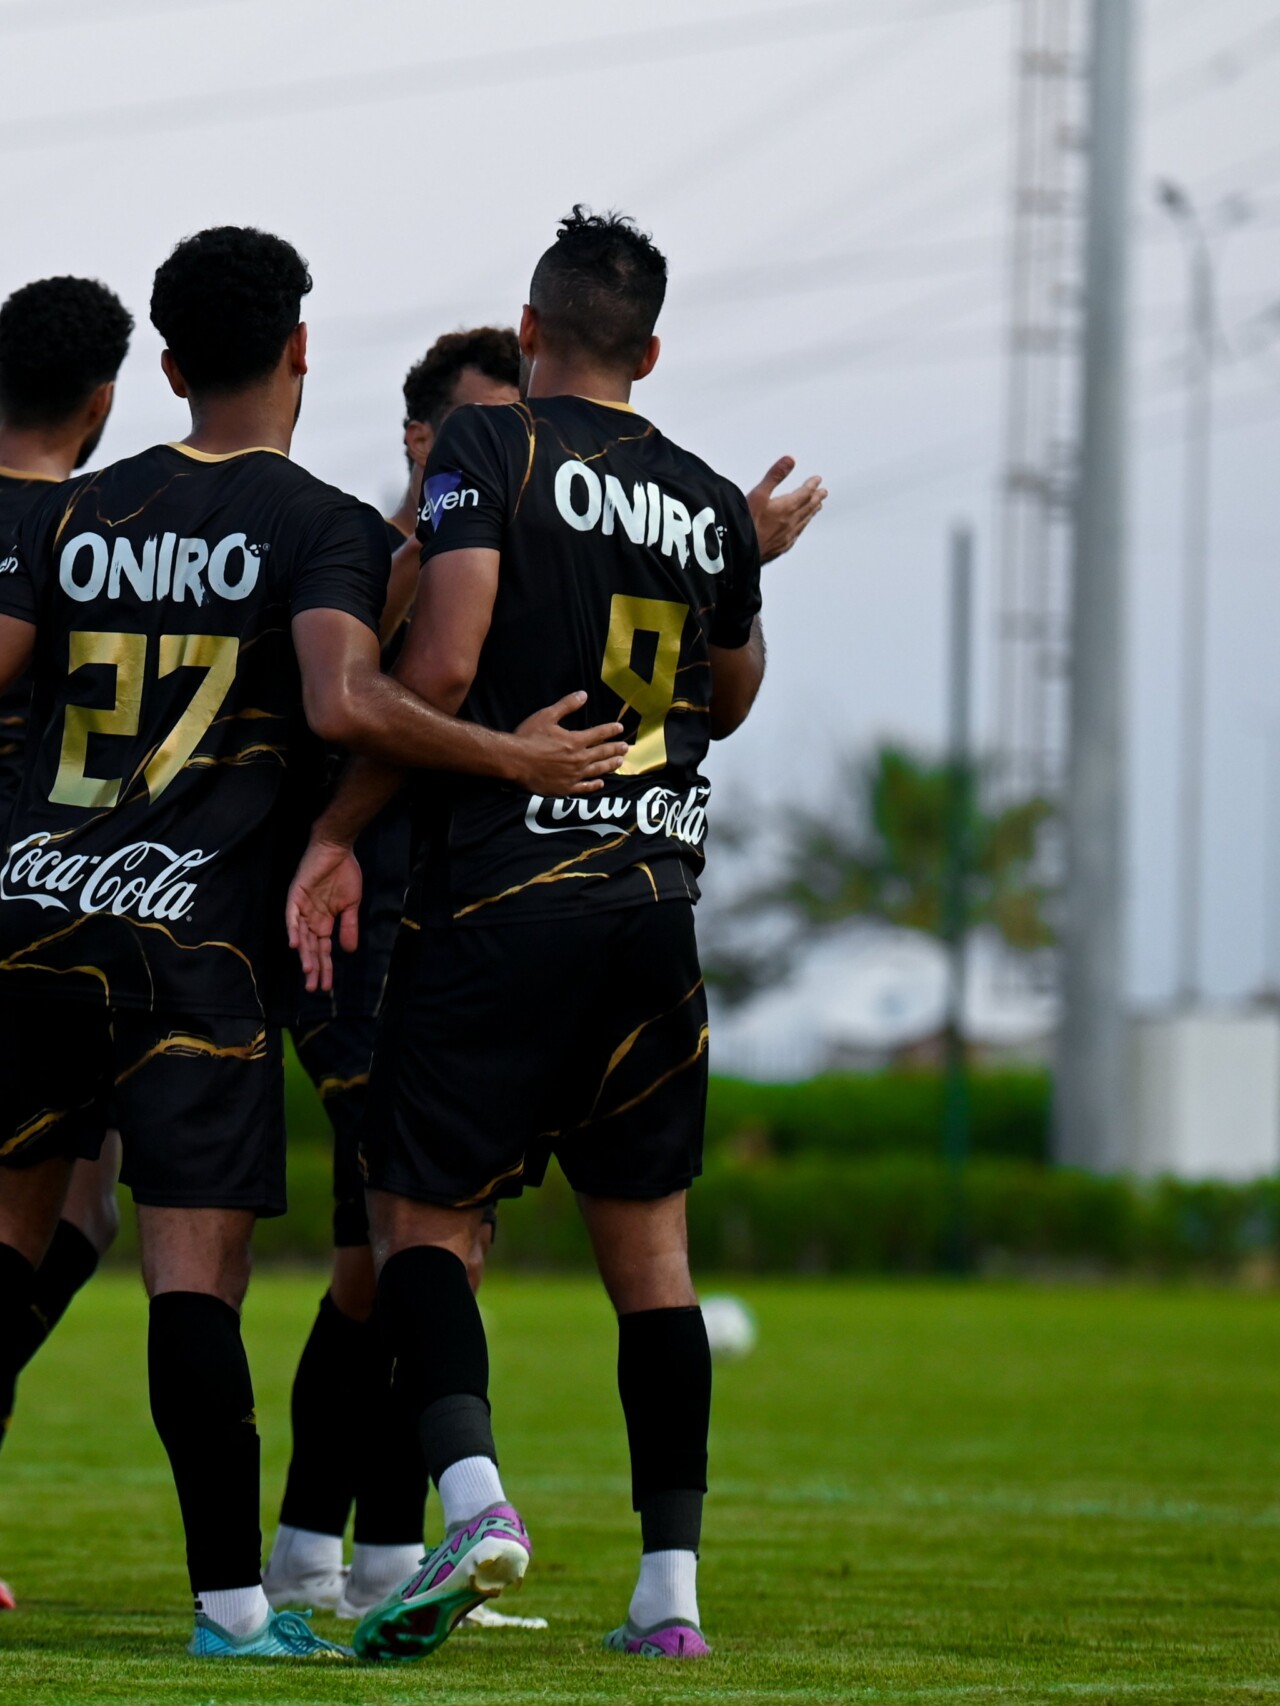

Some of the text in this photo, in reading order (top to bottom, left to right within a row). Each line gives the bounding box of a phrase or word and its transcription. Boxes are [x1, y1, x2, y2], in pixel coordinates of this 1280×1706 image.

[59, 531, 262, 607] ONIRO
[554, 459, 728, 575] ONIRO
[48, 631, 240, 808] 27
[600, 593, 690, 776] 9
[0, 832, 219, 921] Coca-Cola
